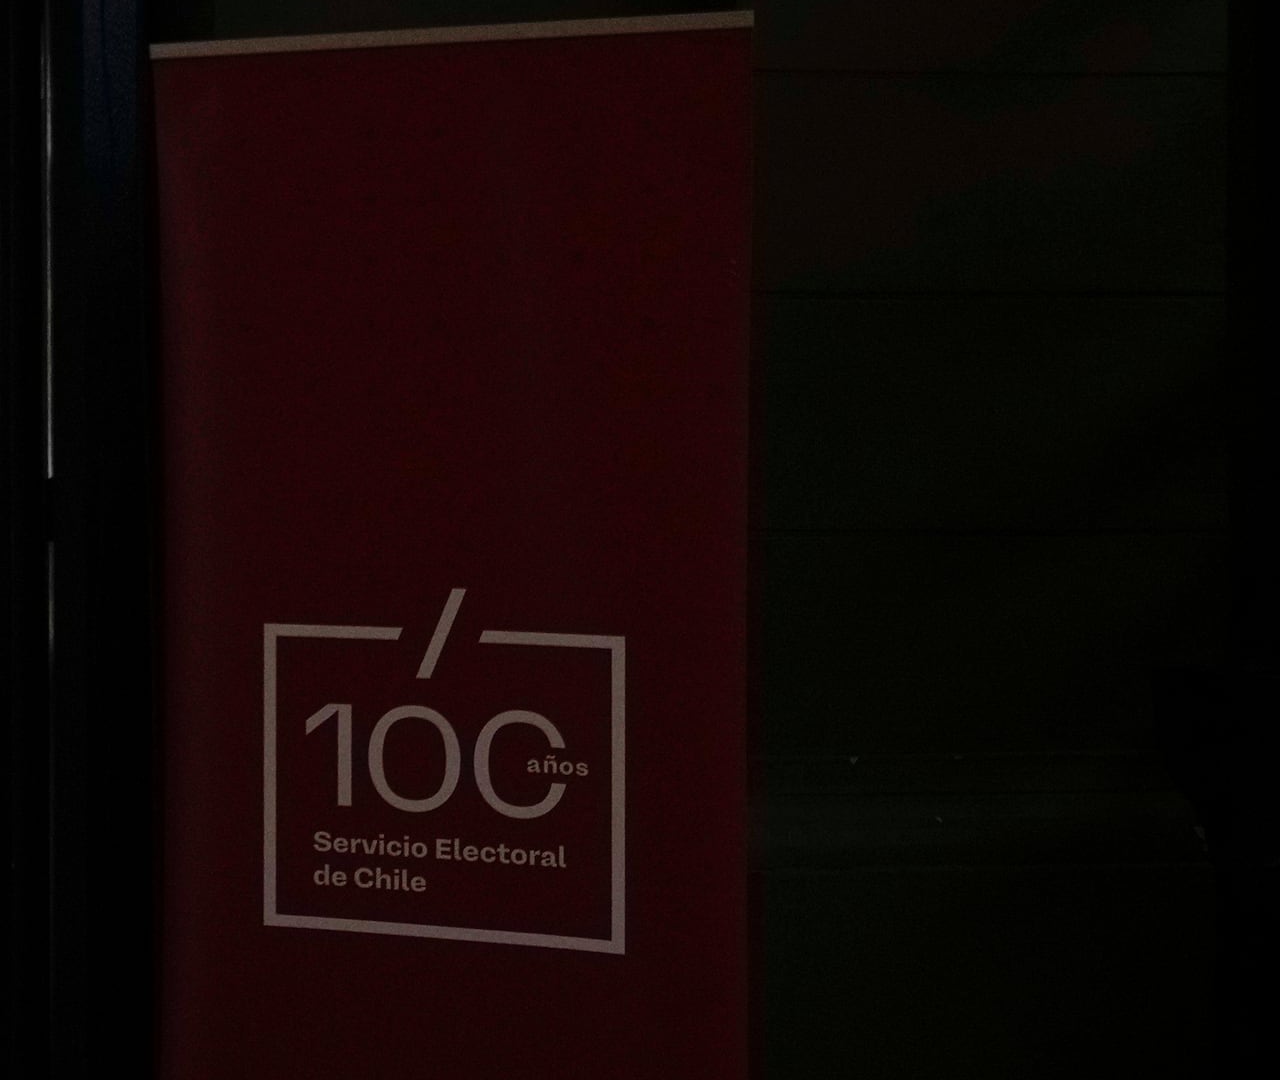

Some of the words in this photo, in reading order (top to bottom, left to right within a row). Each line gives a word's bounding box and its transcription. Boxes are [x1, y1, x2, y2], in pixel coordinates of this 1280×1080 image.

[526, 754, 590, 777] años
[312, 830, 429, 860] Servicio
[434, 837, 568, 869] Electoral
[312, 863, 348, 888] de
[353, 866, 428, 893] Chile
